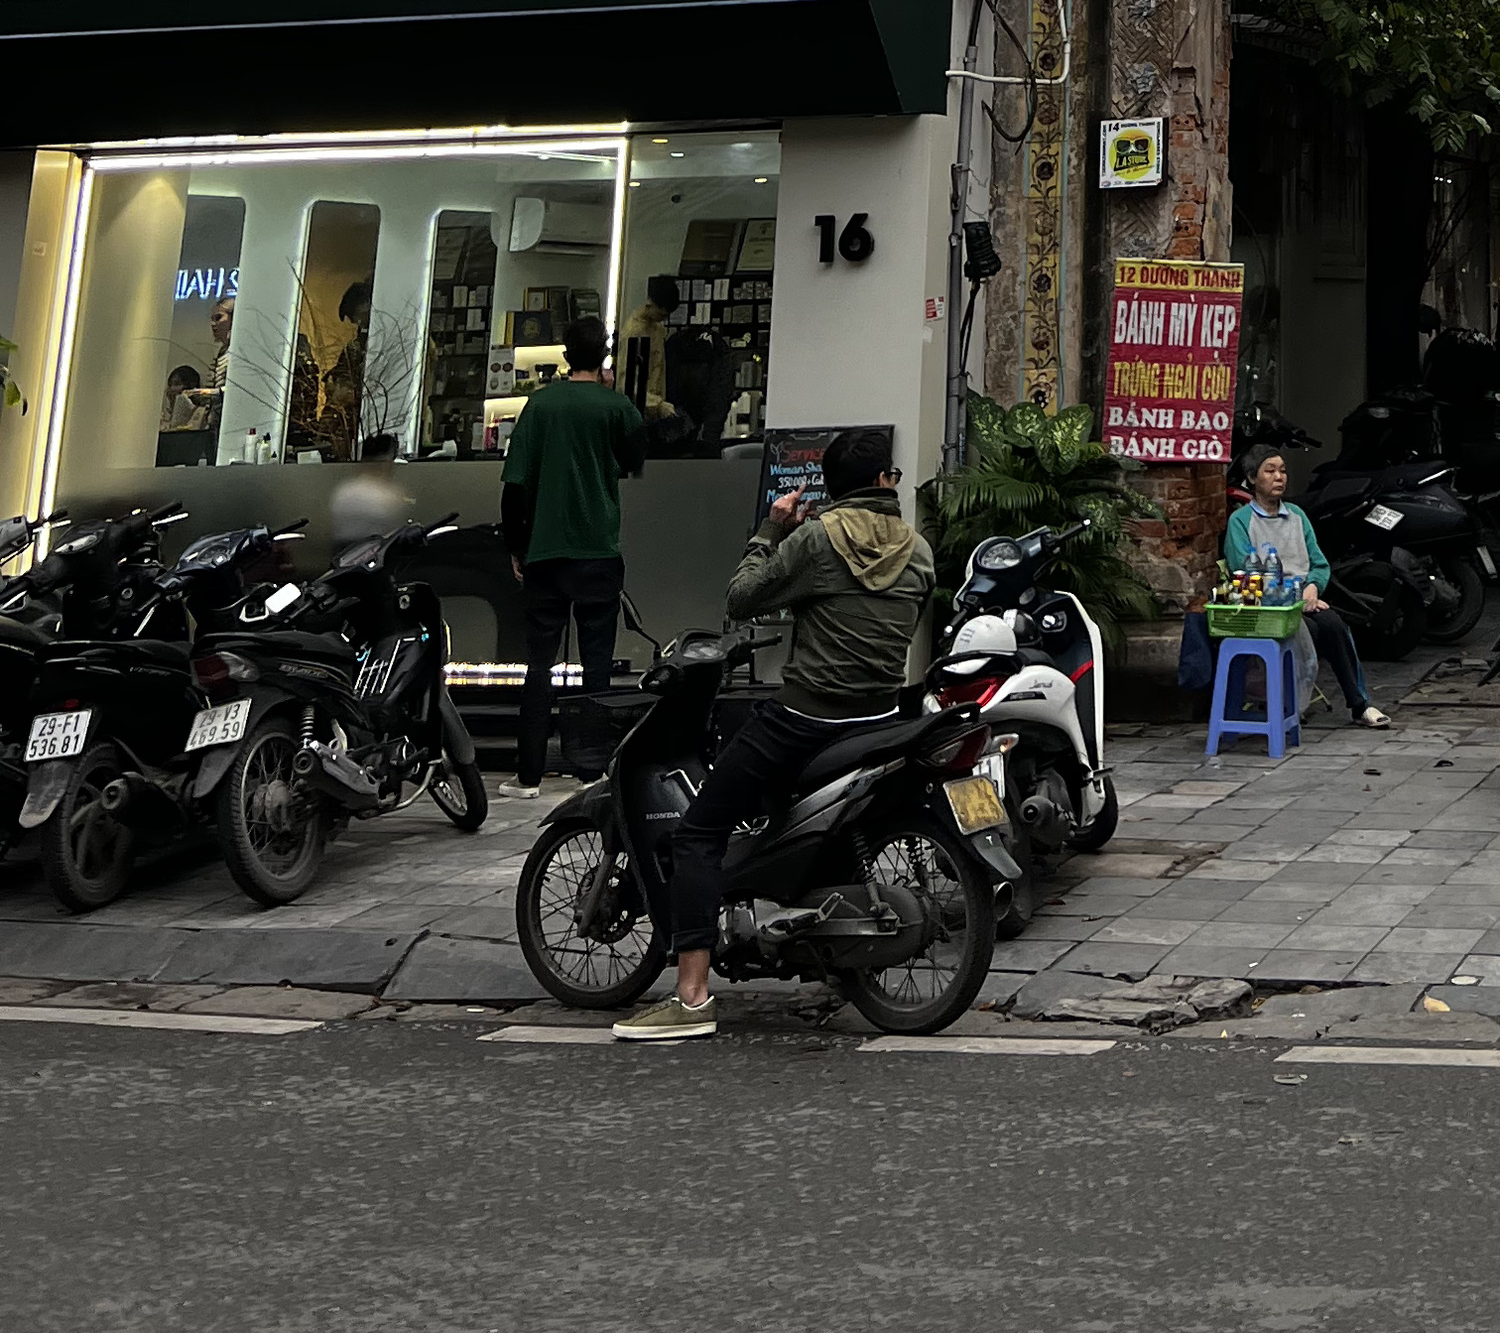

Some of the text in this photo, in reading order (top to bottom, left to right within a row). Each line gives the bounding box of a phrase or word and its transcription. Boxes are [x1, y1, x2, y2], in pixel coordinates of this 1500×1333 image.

[814, 213, 875, 264] 16
[1119, 266, 1136, 283] 12
[1114, 292, 1165, 346] BÁNH
[1168, 294, 1198, 347] MỲ
[1108, 402, 1229, 431] BÁNH BAO
[1109, 431, 1224, 460] BÁNH GIÒ
[38, 714, 80, 737] 29-F1
[190, 721, 240, 747] 469.59
[28, 734, 80, 758] 536.81
[645, 811, 681, 821] HONDA
